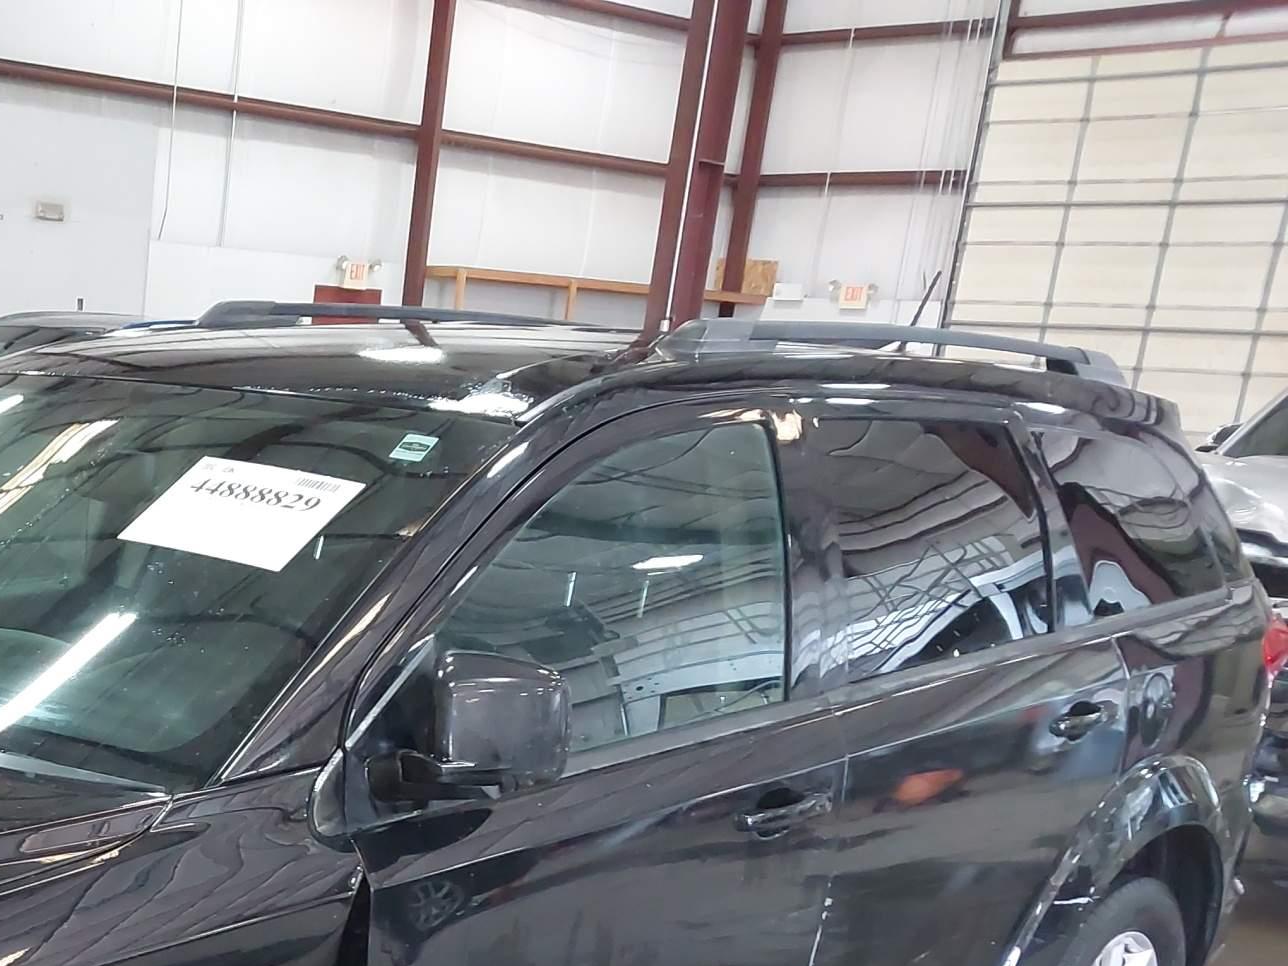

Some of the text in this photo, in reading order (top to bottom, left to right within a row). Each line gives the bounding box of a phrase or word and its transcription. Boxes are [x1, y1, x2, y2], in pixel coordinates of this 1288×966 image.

[350, 263, 366, 280] EXIT
[844, 286, 864, 301] EXIT
[190, 478, 321, 512] 44888829
